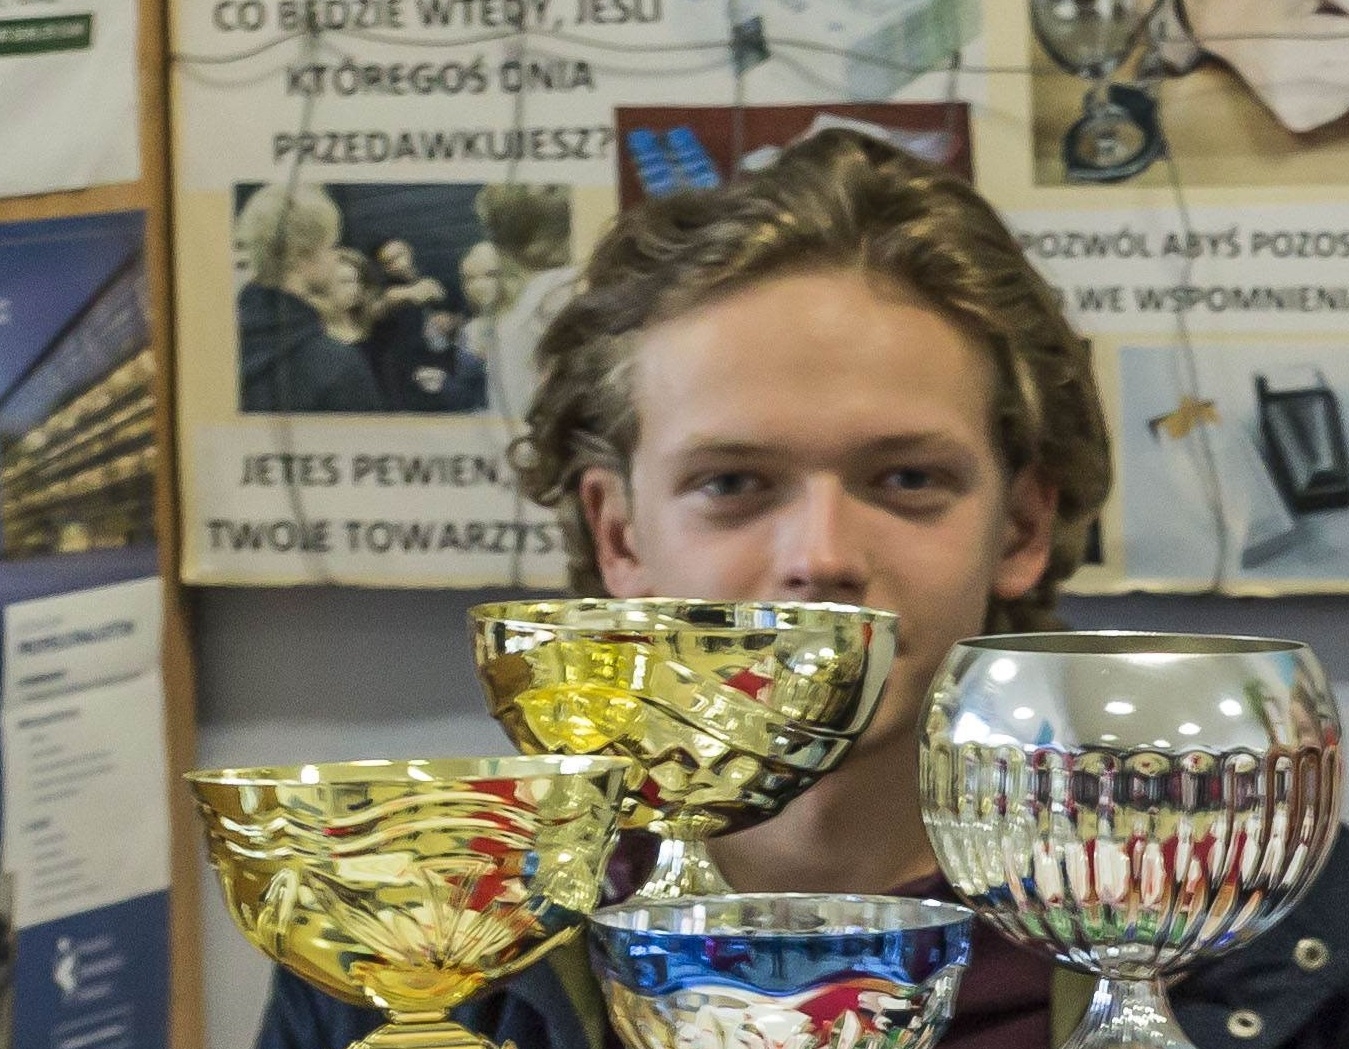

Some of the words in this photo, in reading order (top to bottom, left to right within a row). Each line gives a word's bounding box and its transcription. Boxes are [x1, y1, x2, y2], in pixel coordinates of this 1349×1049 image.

[213, 0, 265, 31] CO
[272, 126, 615, 165] PRZEDAWKUJESZ?
[1161, 225, 1241, 259] ABYŚ
[1078, 285, 1124, 312] WE
